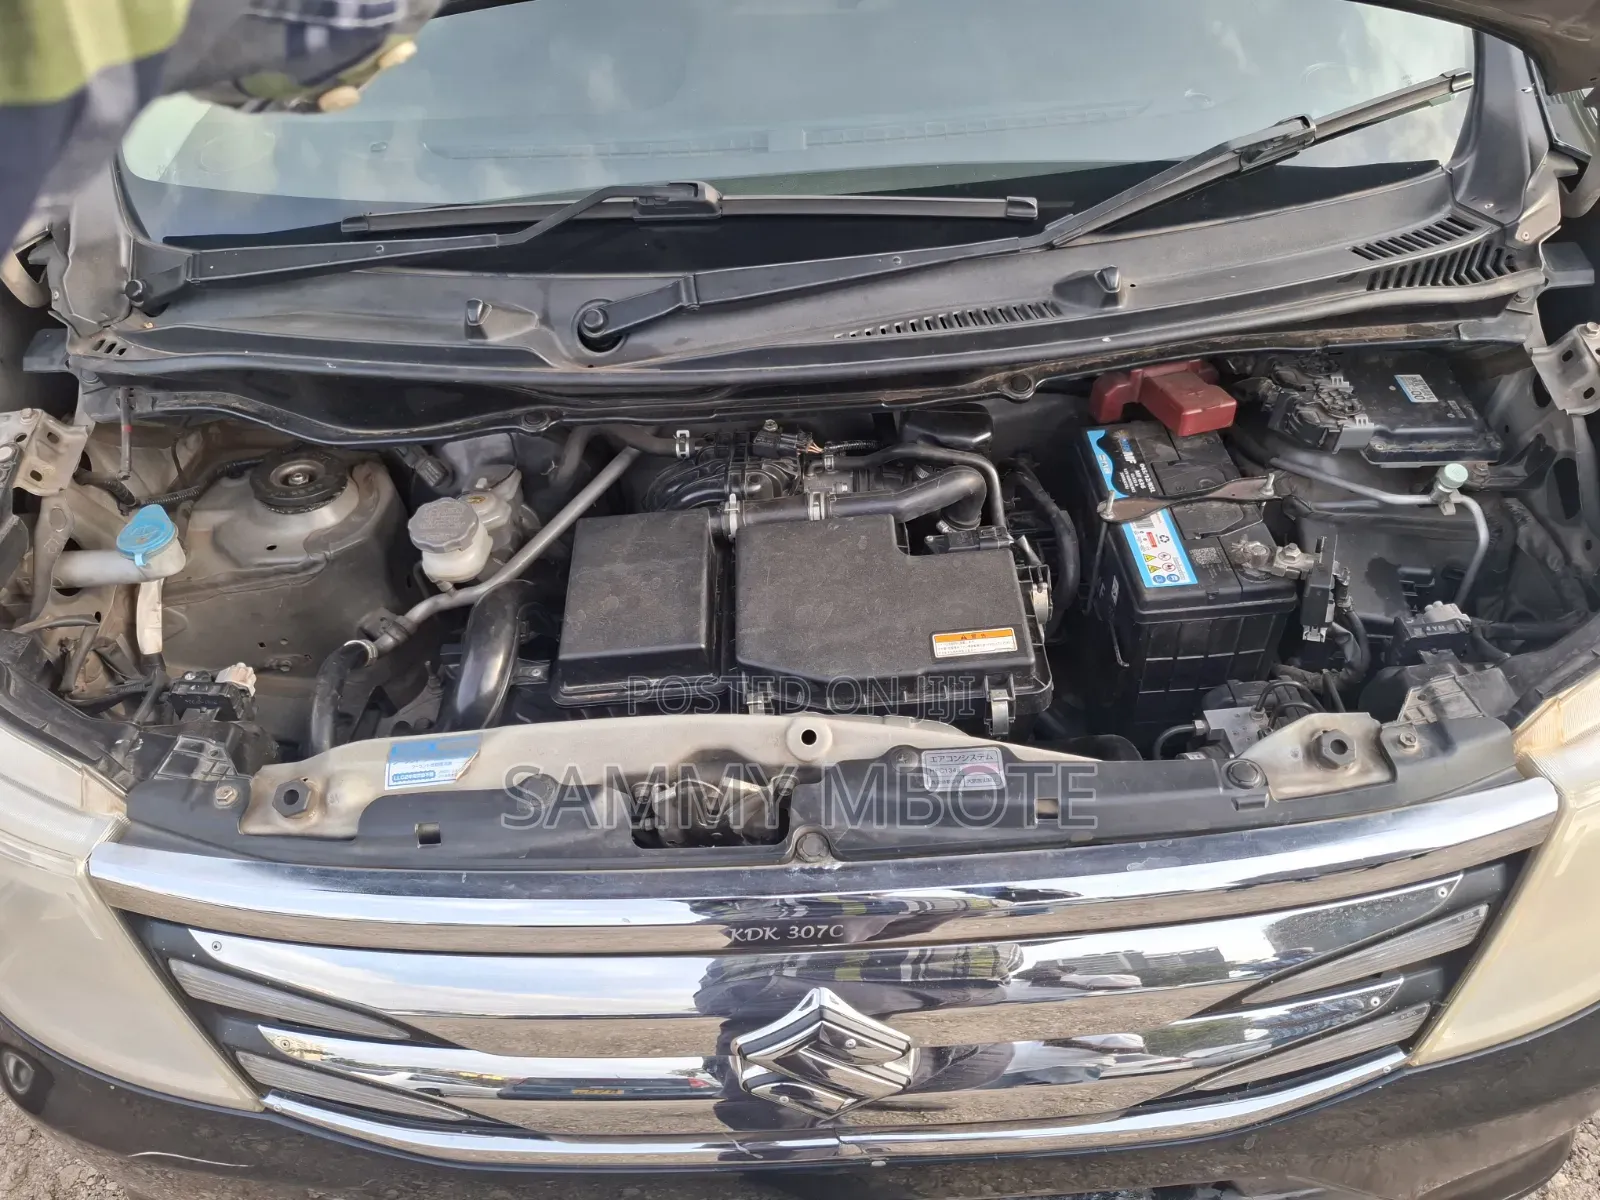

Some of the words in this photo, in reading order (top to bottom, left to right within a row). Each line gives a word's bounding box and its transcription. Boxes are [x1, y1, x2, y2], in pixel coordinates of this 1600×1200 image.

[930, 753, 994, 763] エアコンシステム
[728, 926, 781, 942] KDK
[786, 924, 844, 940] 307C
